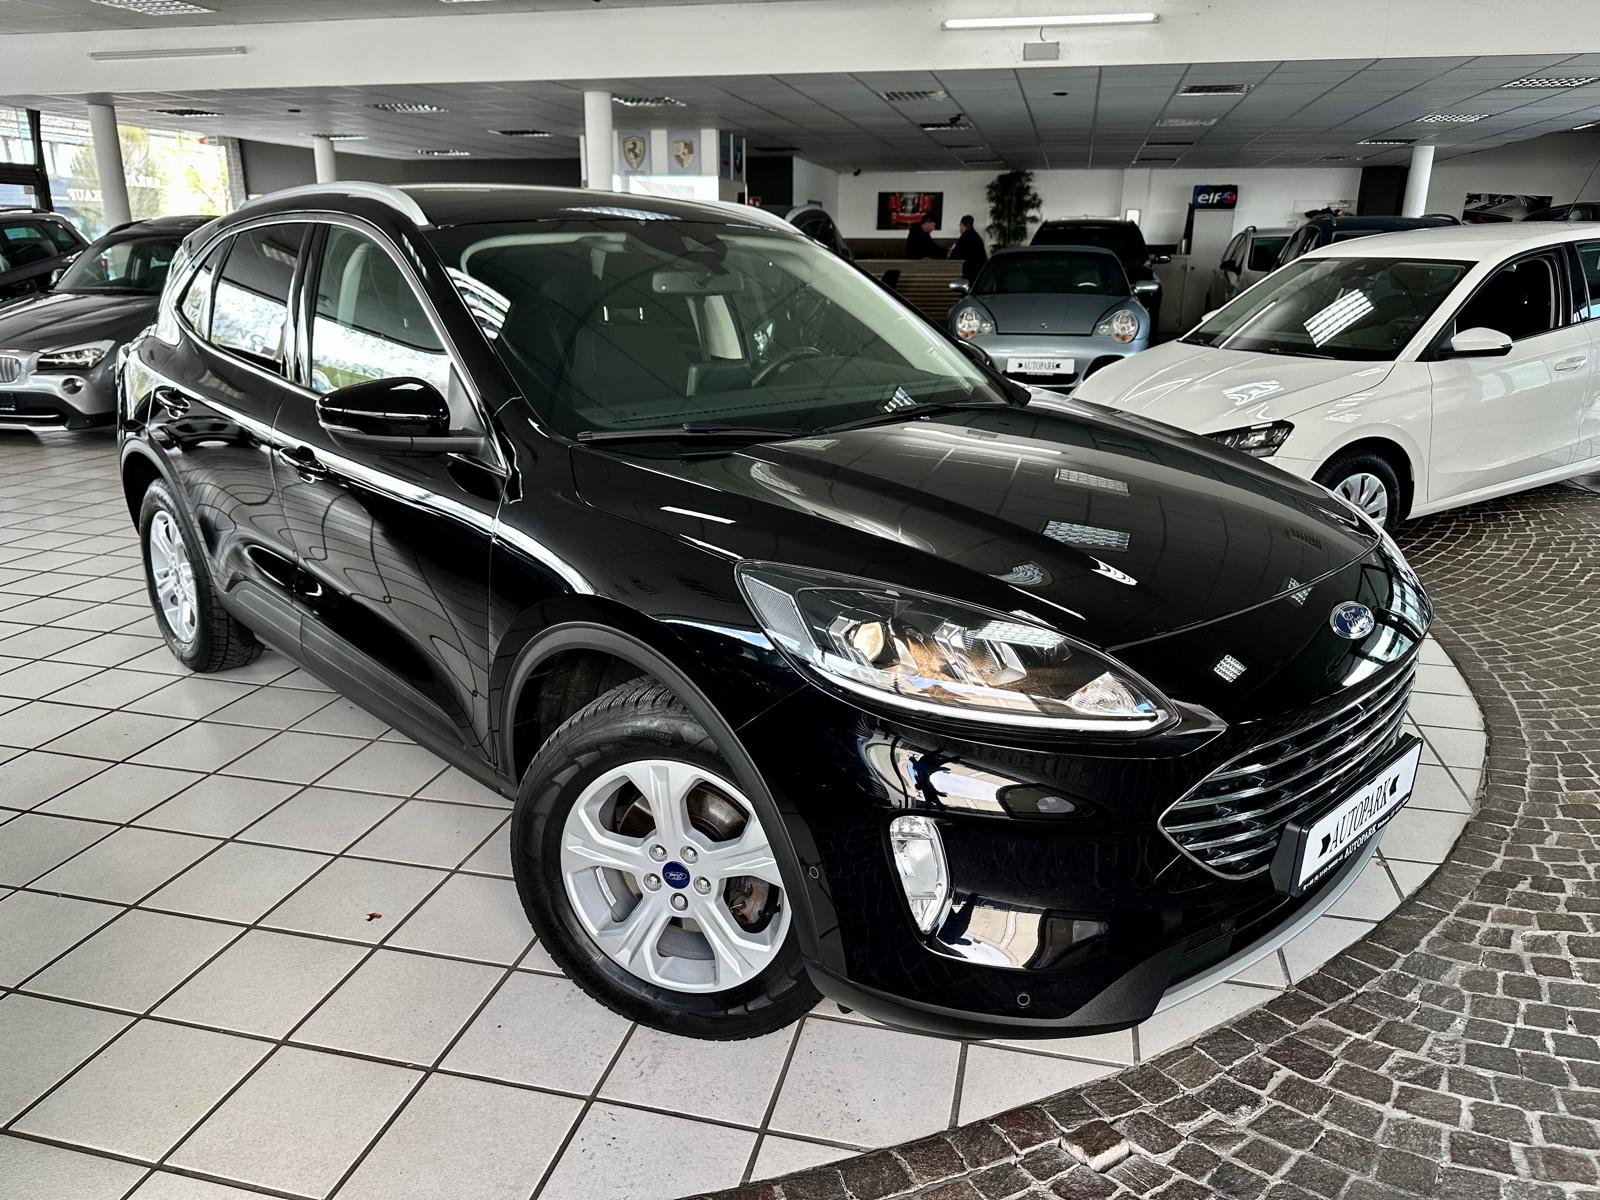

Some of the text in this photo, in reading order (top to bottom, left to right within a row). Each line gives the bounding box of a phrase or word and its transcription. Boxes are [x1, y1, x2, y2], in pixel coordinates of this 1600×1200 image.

[1197, 192, 1222, 204] elf
[1024, 361, 1056, 371] AUTOPARK
[1329, 777, 1391, 853] AUTOPARK
[1344, 823, 1378, 859] AUTOPARK
